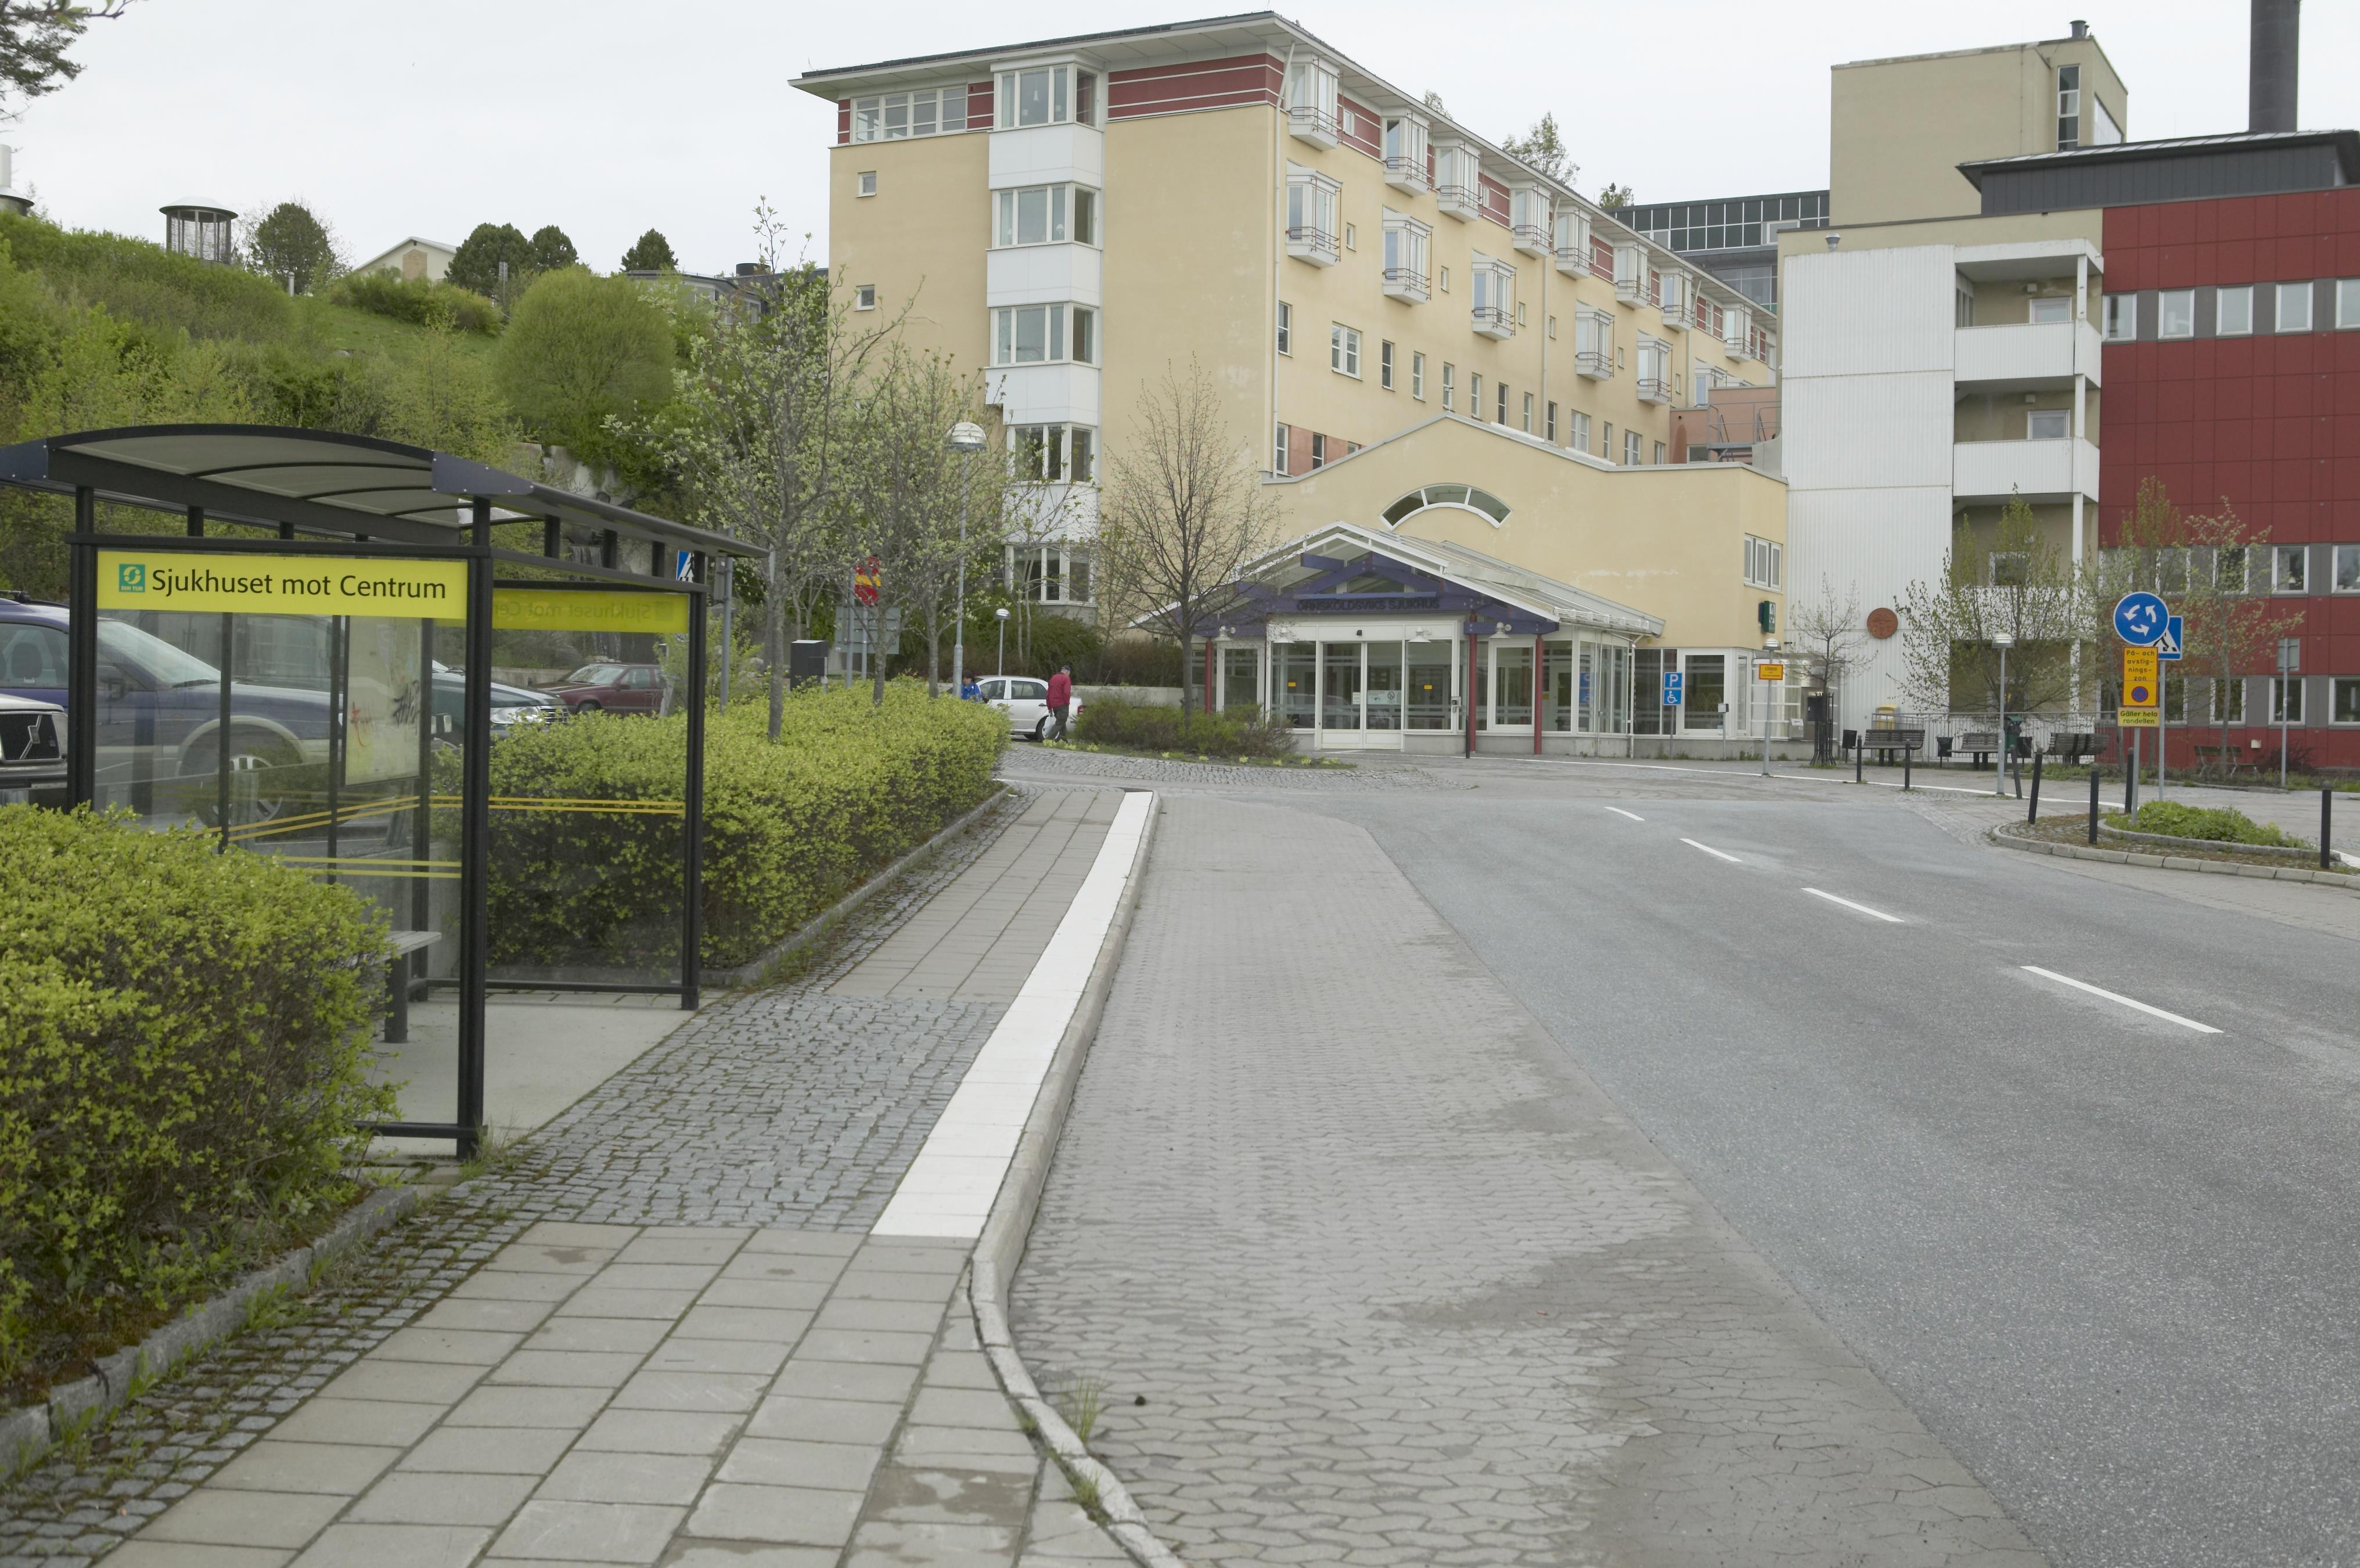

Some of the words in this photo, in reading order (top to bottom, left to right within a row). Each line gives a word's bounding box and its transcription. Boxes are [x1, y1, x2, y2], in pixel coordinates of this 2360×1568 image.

[152, 569, 273, 597] Sjukhuset
[282, 576, 331, 595] mot
[340, 576, 446, 599] Centrum
[1388, 597, 1440, 609] SJUKHUS
[1670, 674, 1678, 687] P
